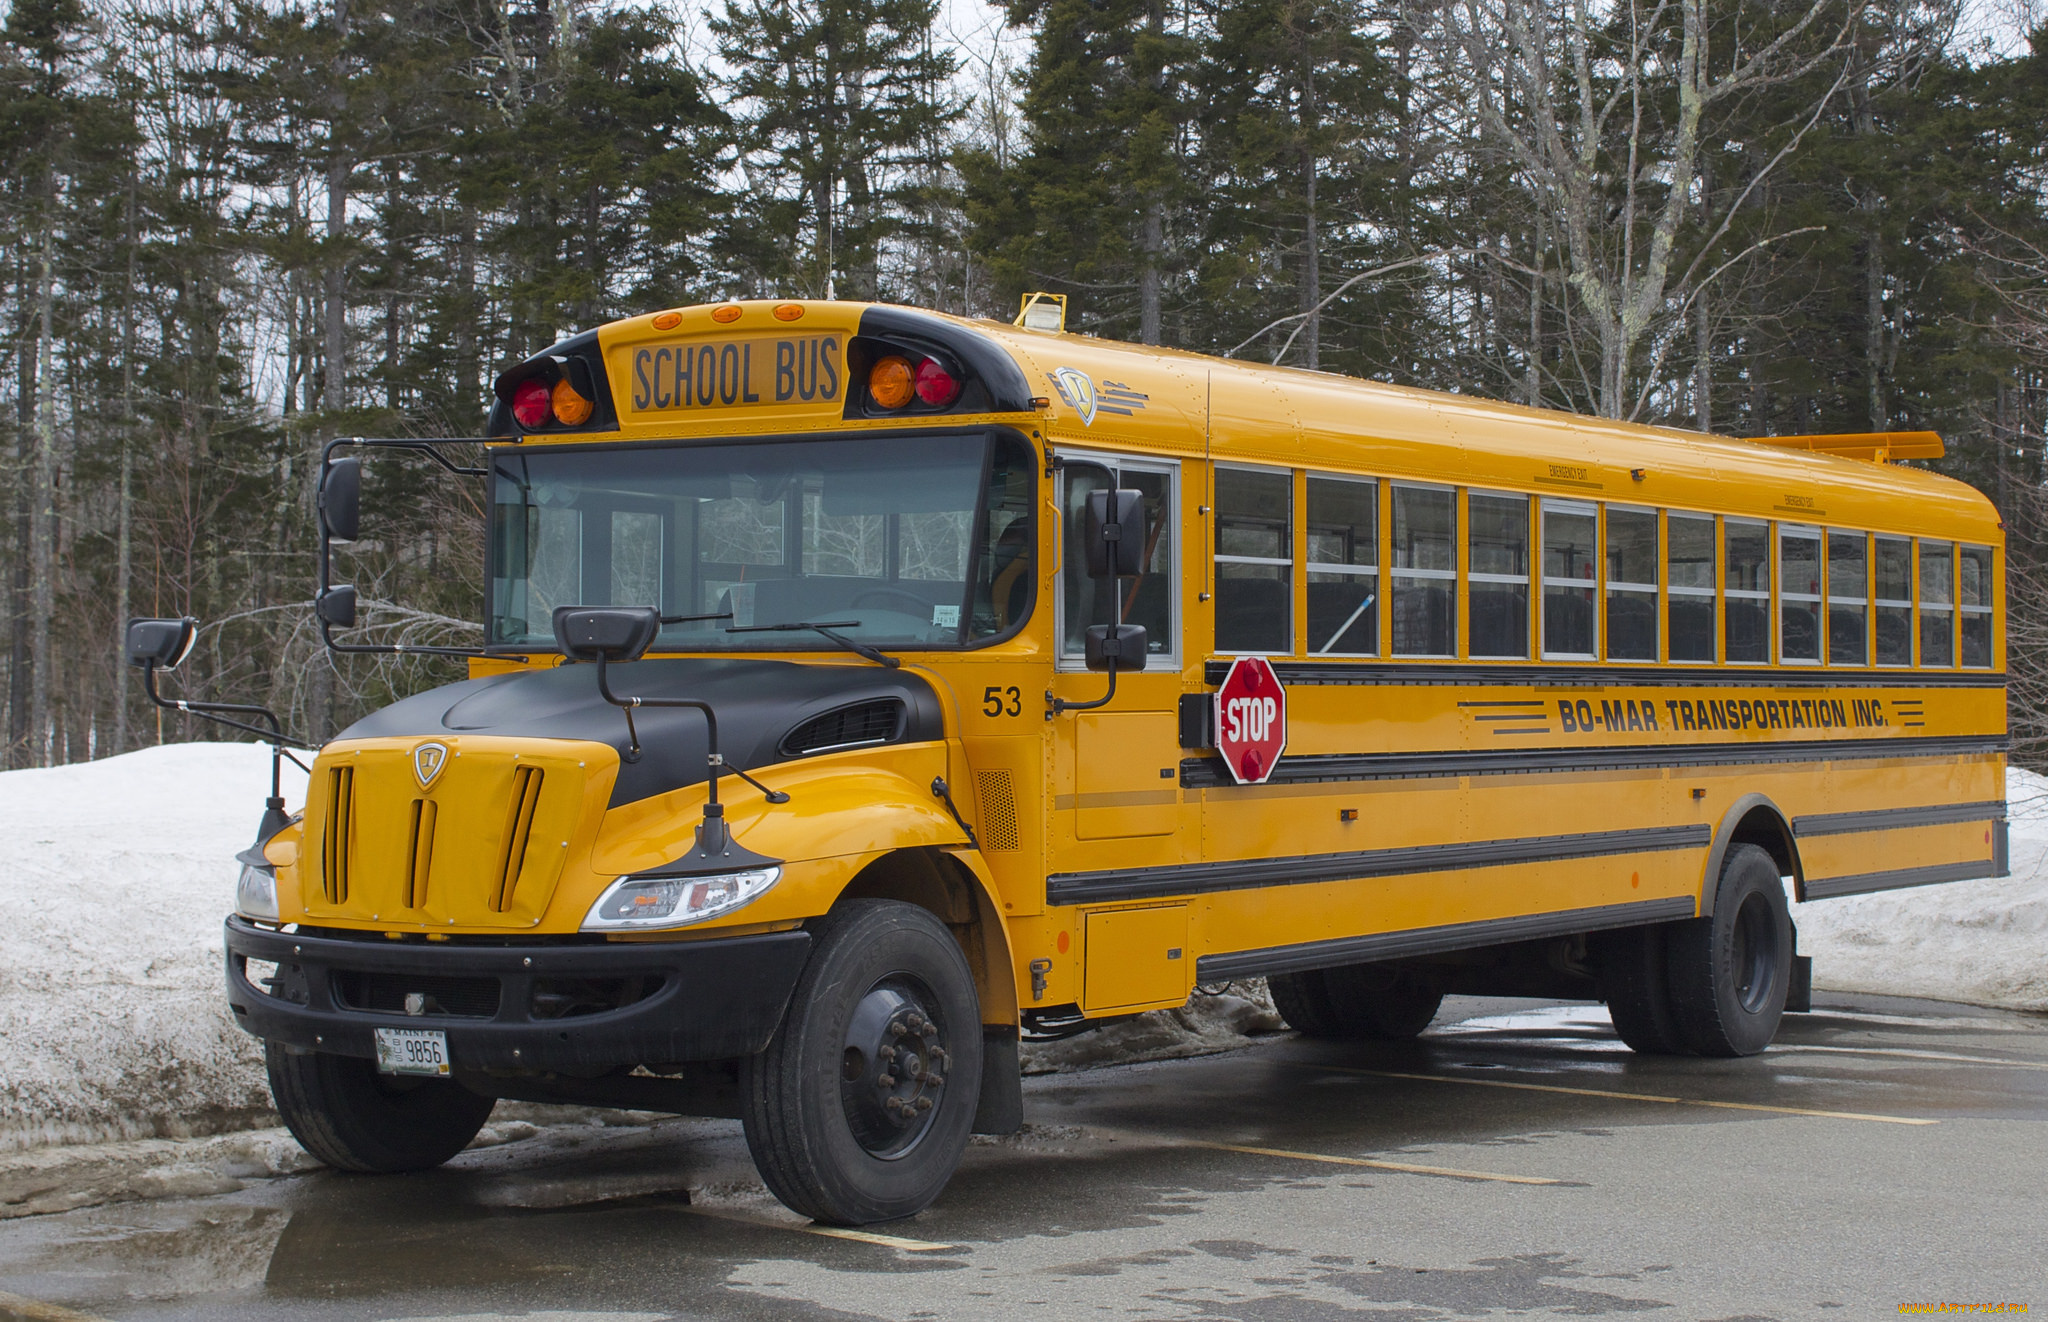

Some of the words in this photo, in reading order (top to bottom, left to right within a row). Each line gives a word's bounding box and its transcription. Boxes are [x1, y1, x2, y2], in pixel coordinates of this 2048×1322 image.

[635, 343, 759, 410] SCHOOL
[775, 337, 838, 401] BUS
[1548, 464, 1577, 480] EMERGENCY
[983, 686, 1021, 717] 53
[1558, 699, 1659, 732] BO-MAR
[1665, 699, 1847, 731] TRANSPORTATION
[1851, 699, 1888, 727] INC.
[1227, 697, 1276, 742] STOP
[392, 1038, 403, 1062] BUS
[405, 1039, 442, 1064] 9856
